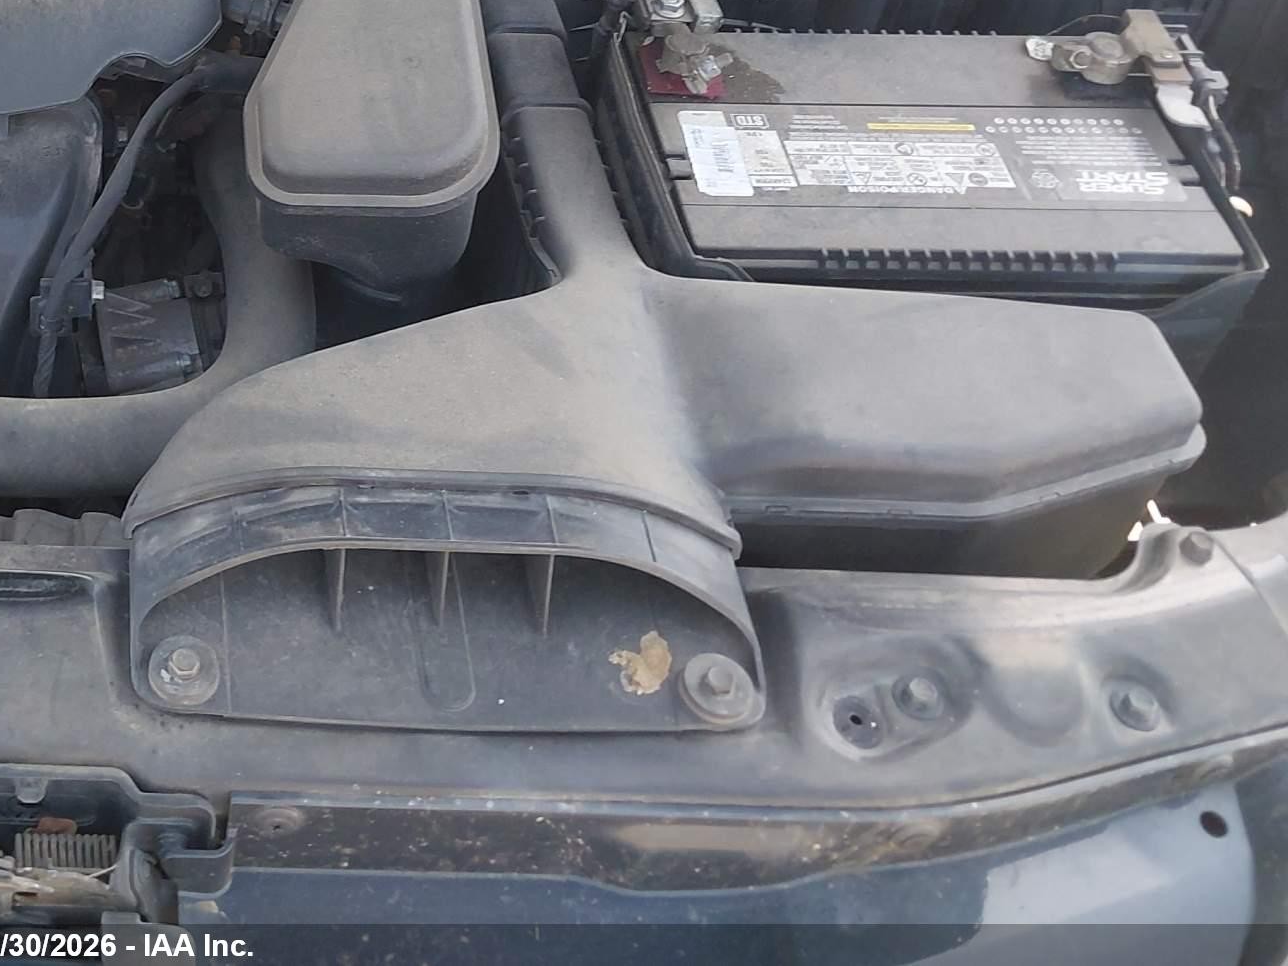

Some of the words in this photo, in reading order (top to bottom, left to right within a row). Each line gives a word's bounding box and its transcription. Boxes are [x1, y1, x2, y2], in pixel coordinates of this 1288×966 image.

[735, 115, 765, 126] STD
[1075, 170, 1169, 185] START
[1078, 181, 1165, 195] SUPER
